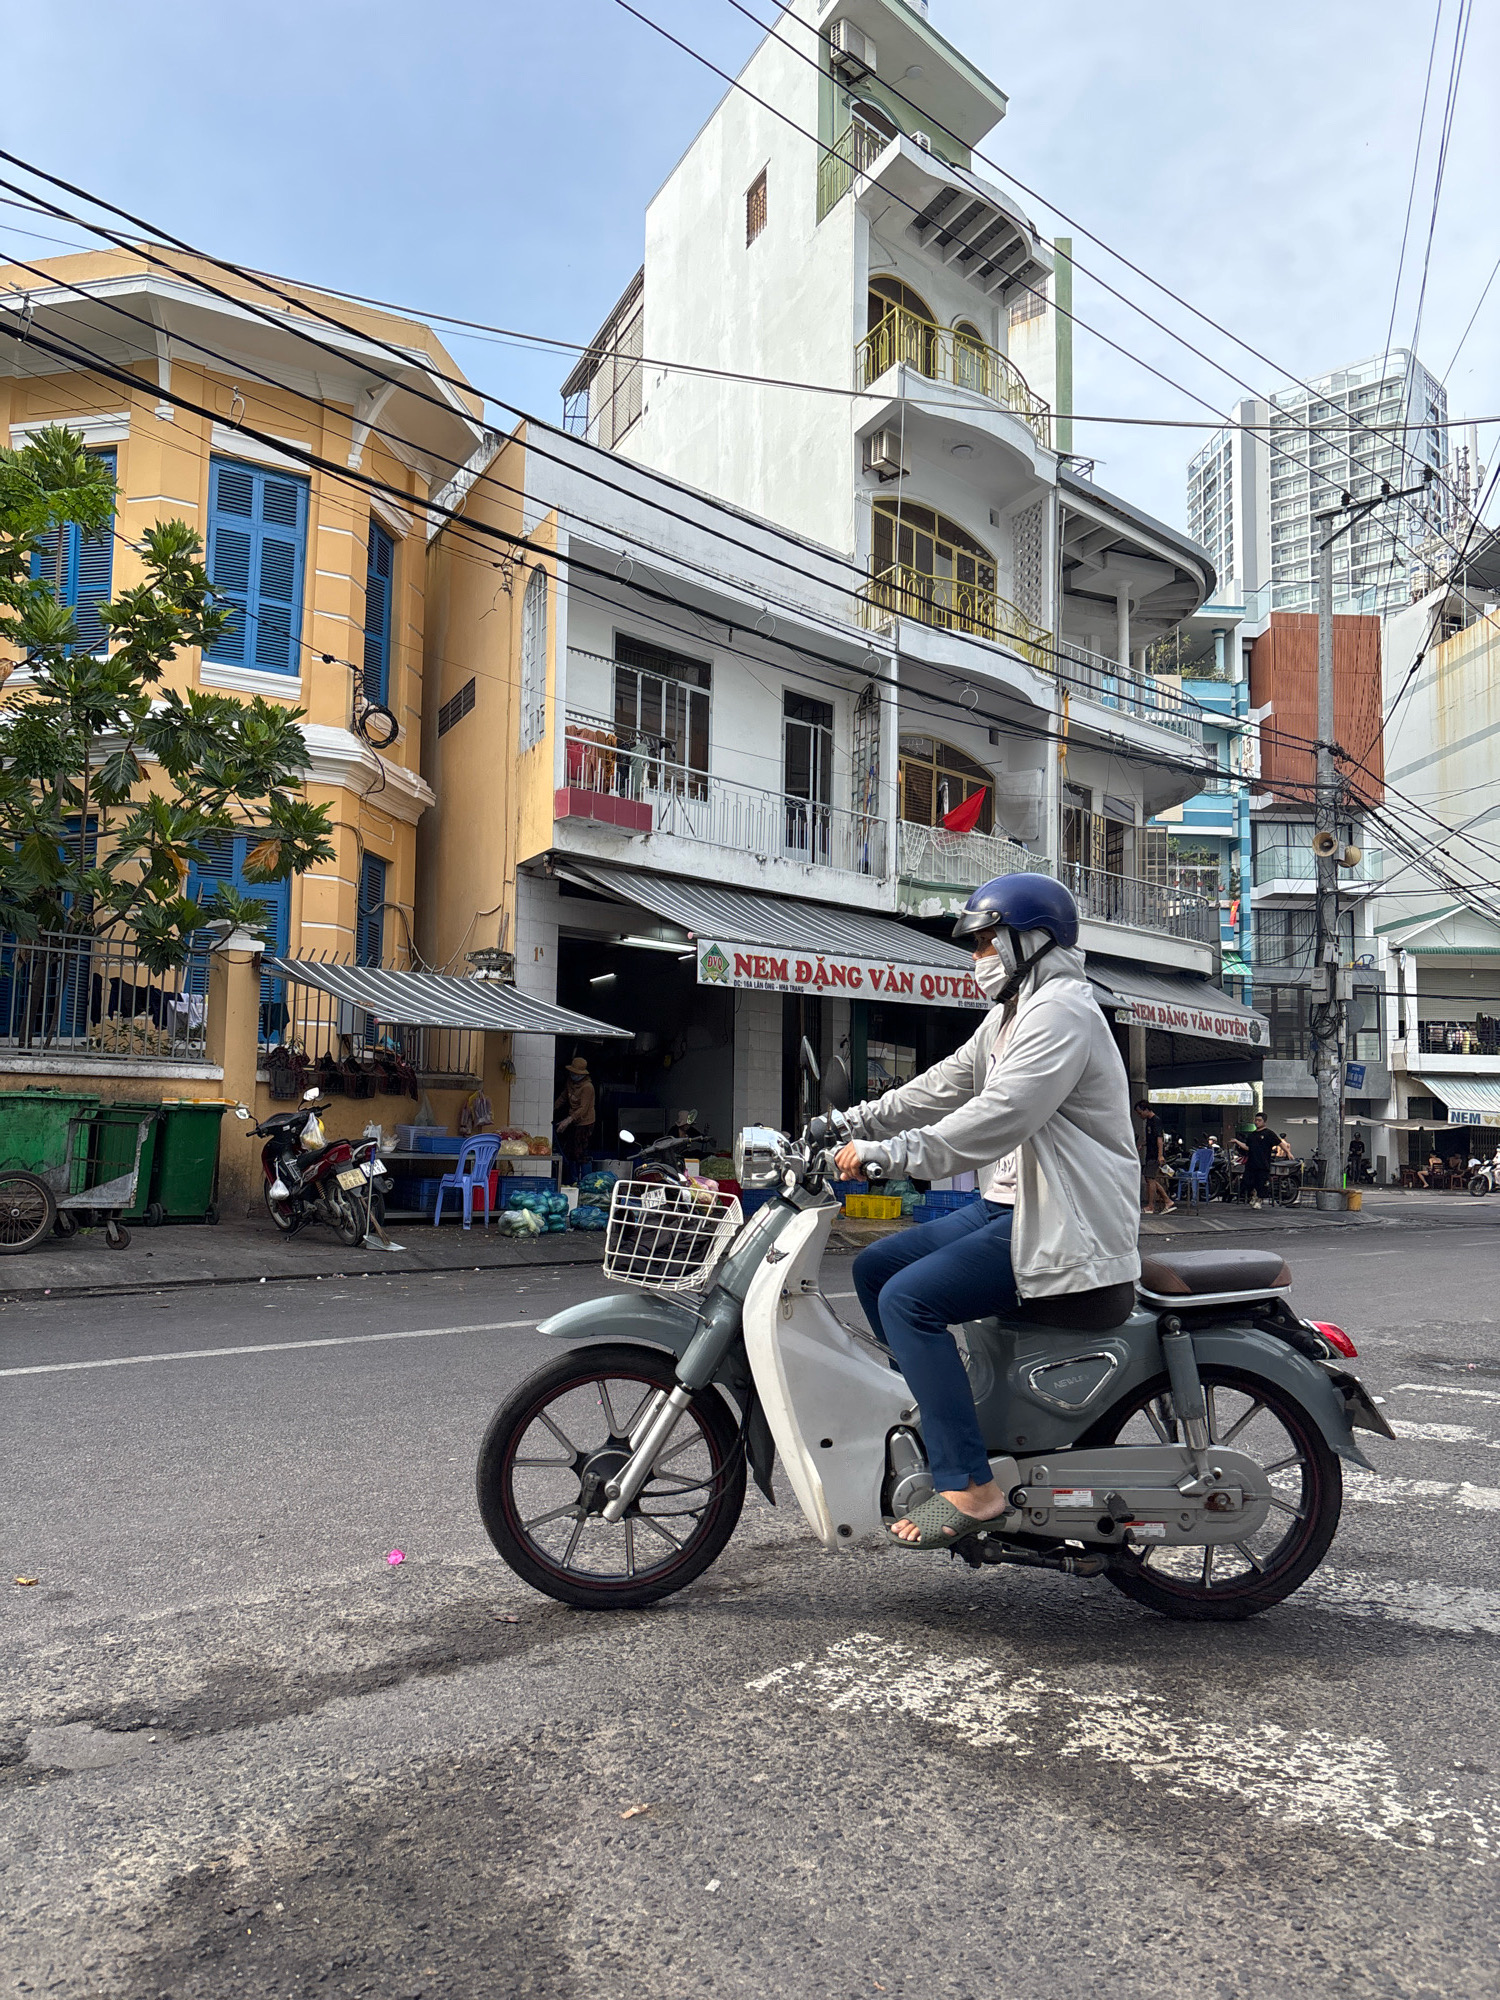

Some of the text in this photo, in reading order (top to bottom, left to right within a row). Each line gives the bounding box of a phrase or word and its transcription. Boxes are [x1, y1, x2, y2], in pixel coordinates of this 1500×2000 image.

[733, 953, 790, 983] NEM
[795, 955, 863, 992] ĐẶNG
[868, 964, 915, 994] VĂN
[1131, 1002, 1156, 1022] NEM
[1158, 1005, 1188, 1029] ĐẶNG
[1190, 1011, 1213, 1032] VĂN
[1214, 1017, 1248, 1037] QUYÊN
[1451, 1111, 1481, 1125] NEM
